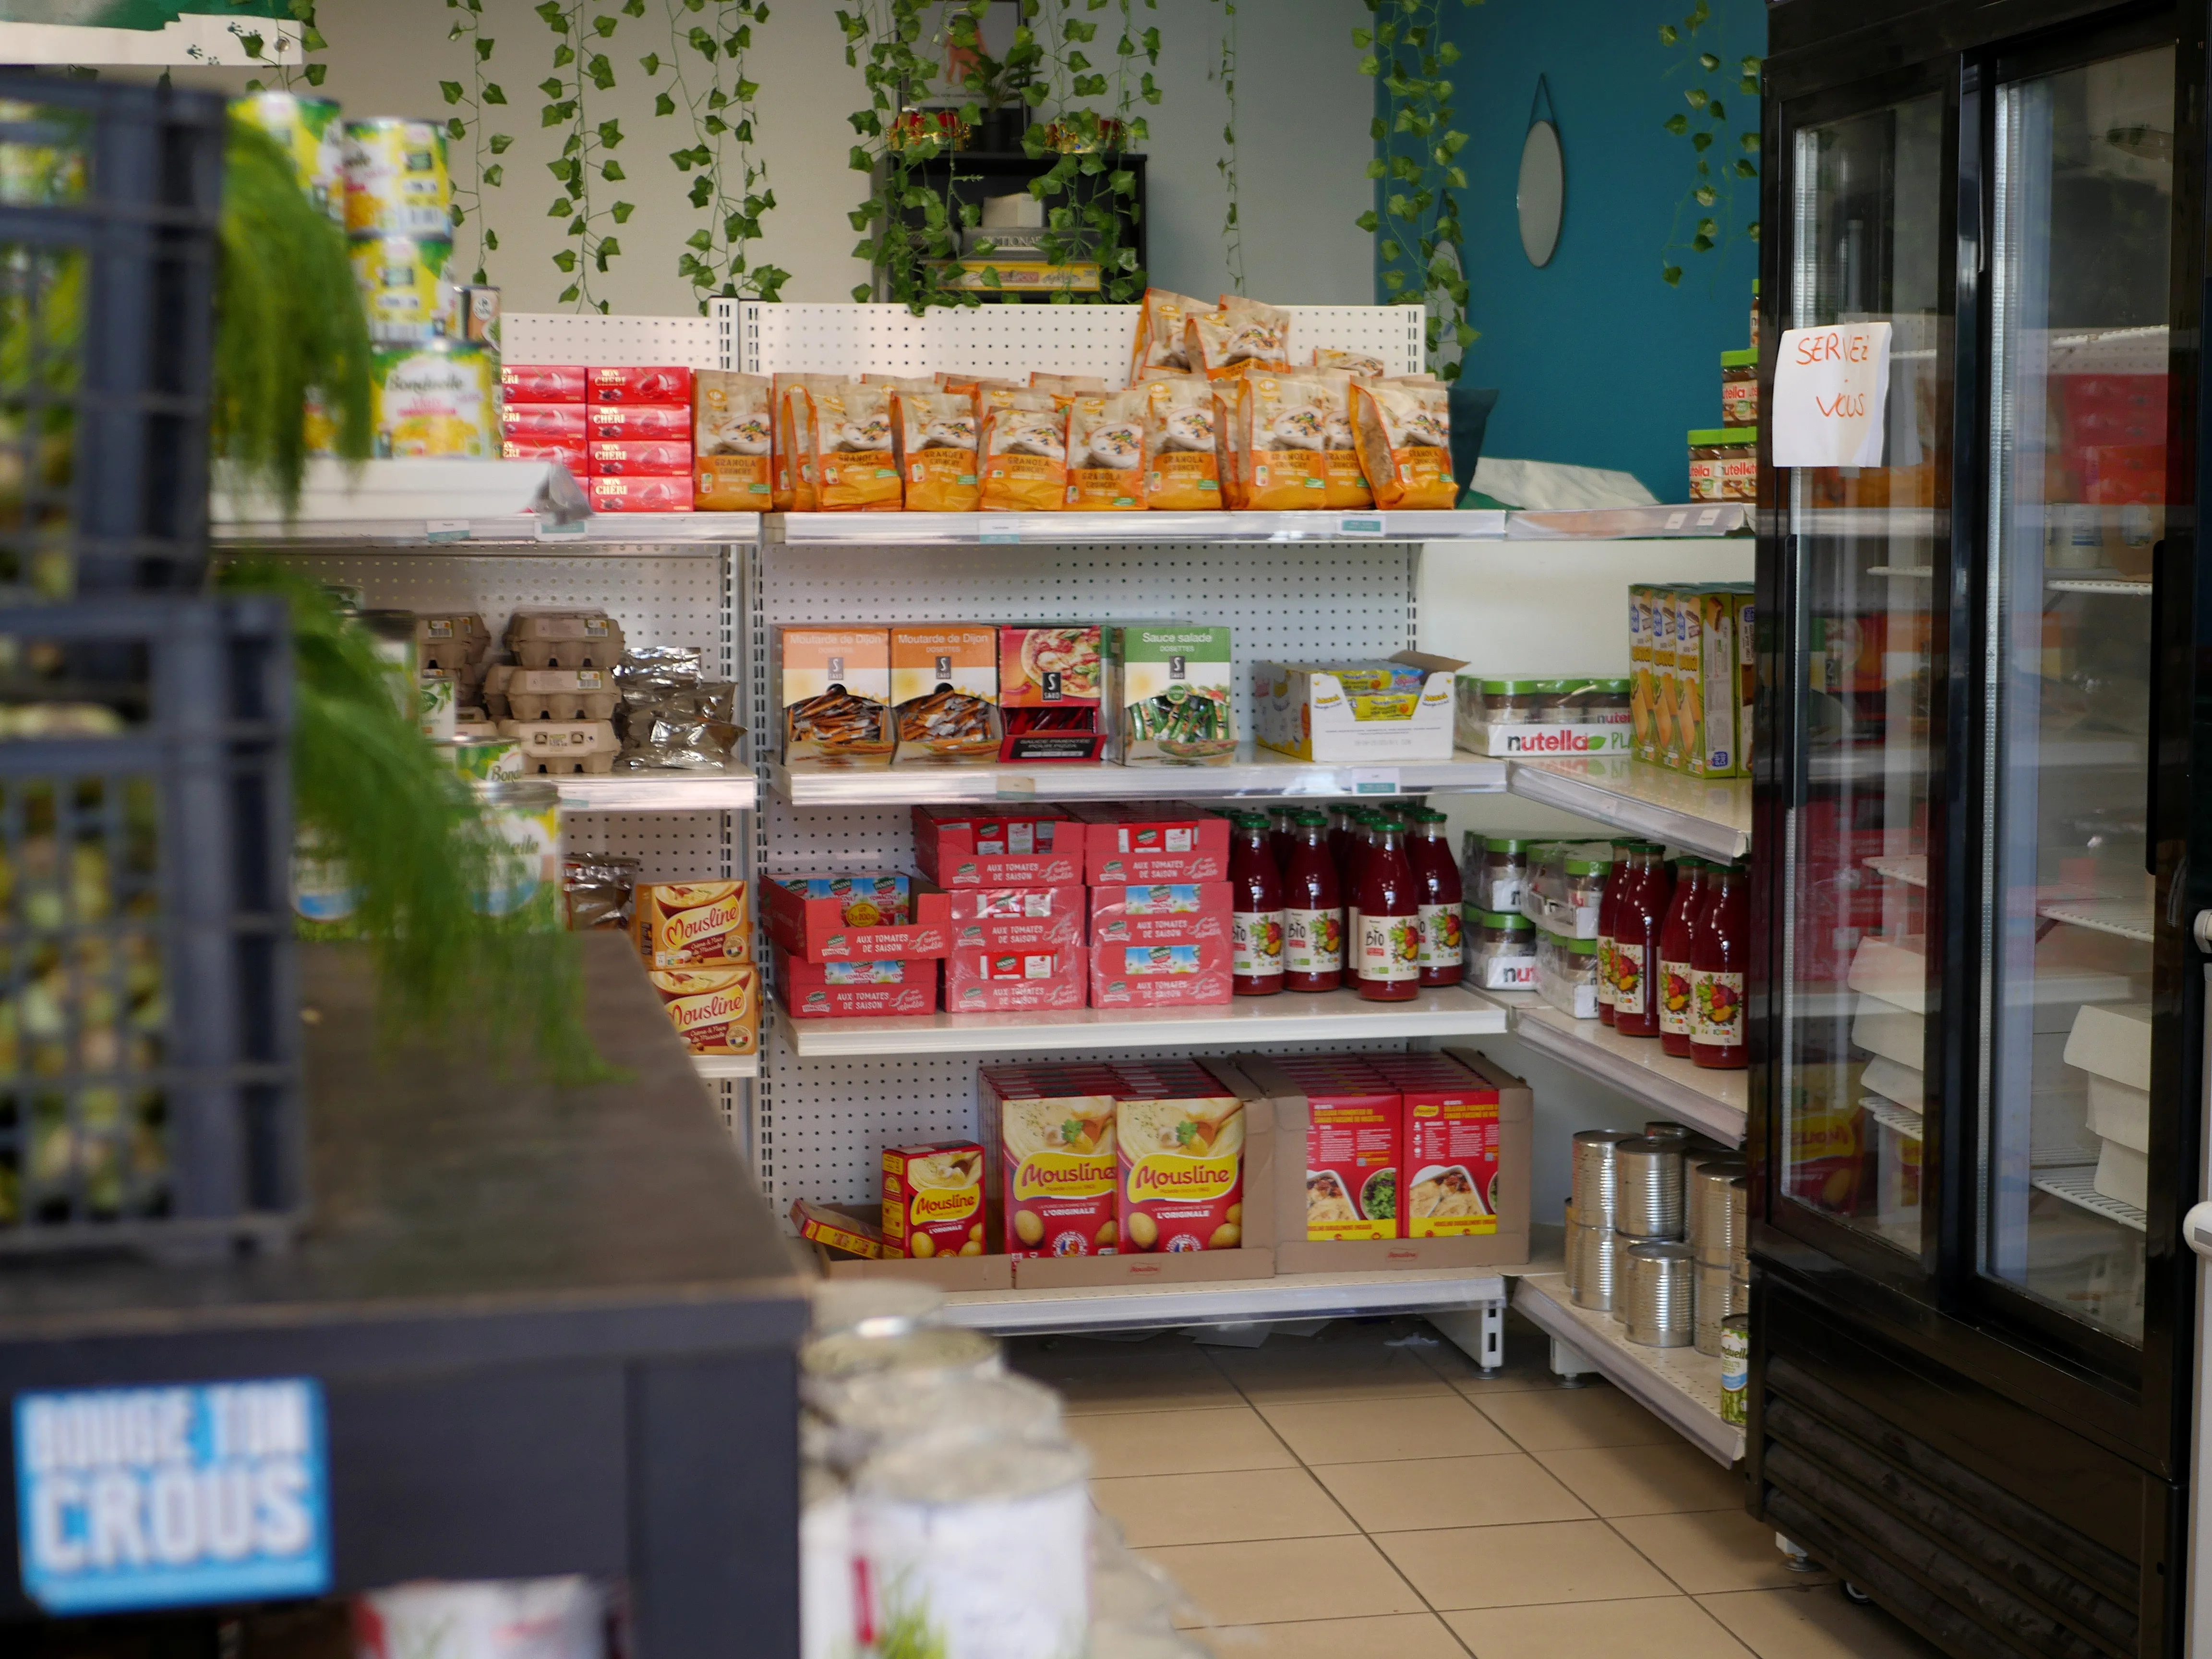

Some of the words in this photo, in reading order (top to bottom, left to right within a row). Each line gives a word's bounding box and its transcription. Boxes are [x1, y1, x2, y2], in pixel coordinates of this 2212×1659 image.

[502, 374, 519, 384] ERI
[1816, 393, 1864, 418] VOUS
[503, 412, 520, 422] ERI
[593, 414, 626, 424] CHERI
[503, 448, 520, 457] ERI
[594, 451, 627, 461] CHERI
[595, 485, 628, 495] CHERI
[790, 635, 837, 644] Moutarde
[840, 635, 853, 644] de
[856, 634, 881, 645] Dijon
[899, 634, 945, 644] Moutarde
[948, 634, 961, 643] de
[962, 633, 987, 645] Dijon
[1142, 632, 1176, 643] Sauce
[1178, 633, 1213, 643] salade
[1597, 712, 1630, 724] nutel
[1507, 729, 1589, 752] nutella
[1006, 863, 1039, 871] TOMATES
[666, 907, 736, 945] Mousline
[856, 935, 872, 944] AUX
[875, 934, 909, 943] TOMATES
[863, 945, 872, 953] DE
[875, 944, 903, 952] SAISON
[837, 993, 852, 1001] AUX
[855, 992, 889, 1000] TOMATES
[843, 1002, 853, 1010] DE
[856, 1001, 883, 1010] SAISON
[1021, 1162, 1117, 1188] Mousline
[1135, 1165, 1231, 1190] Mousline
[916, 1193, 975, 1215] Mousline
[1156, 1210, 1210, 1220] L'ORIGINALE
[29, 1462, 313, 1577] CROUS
